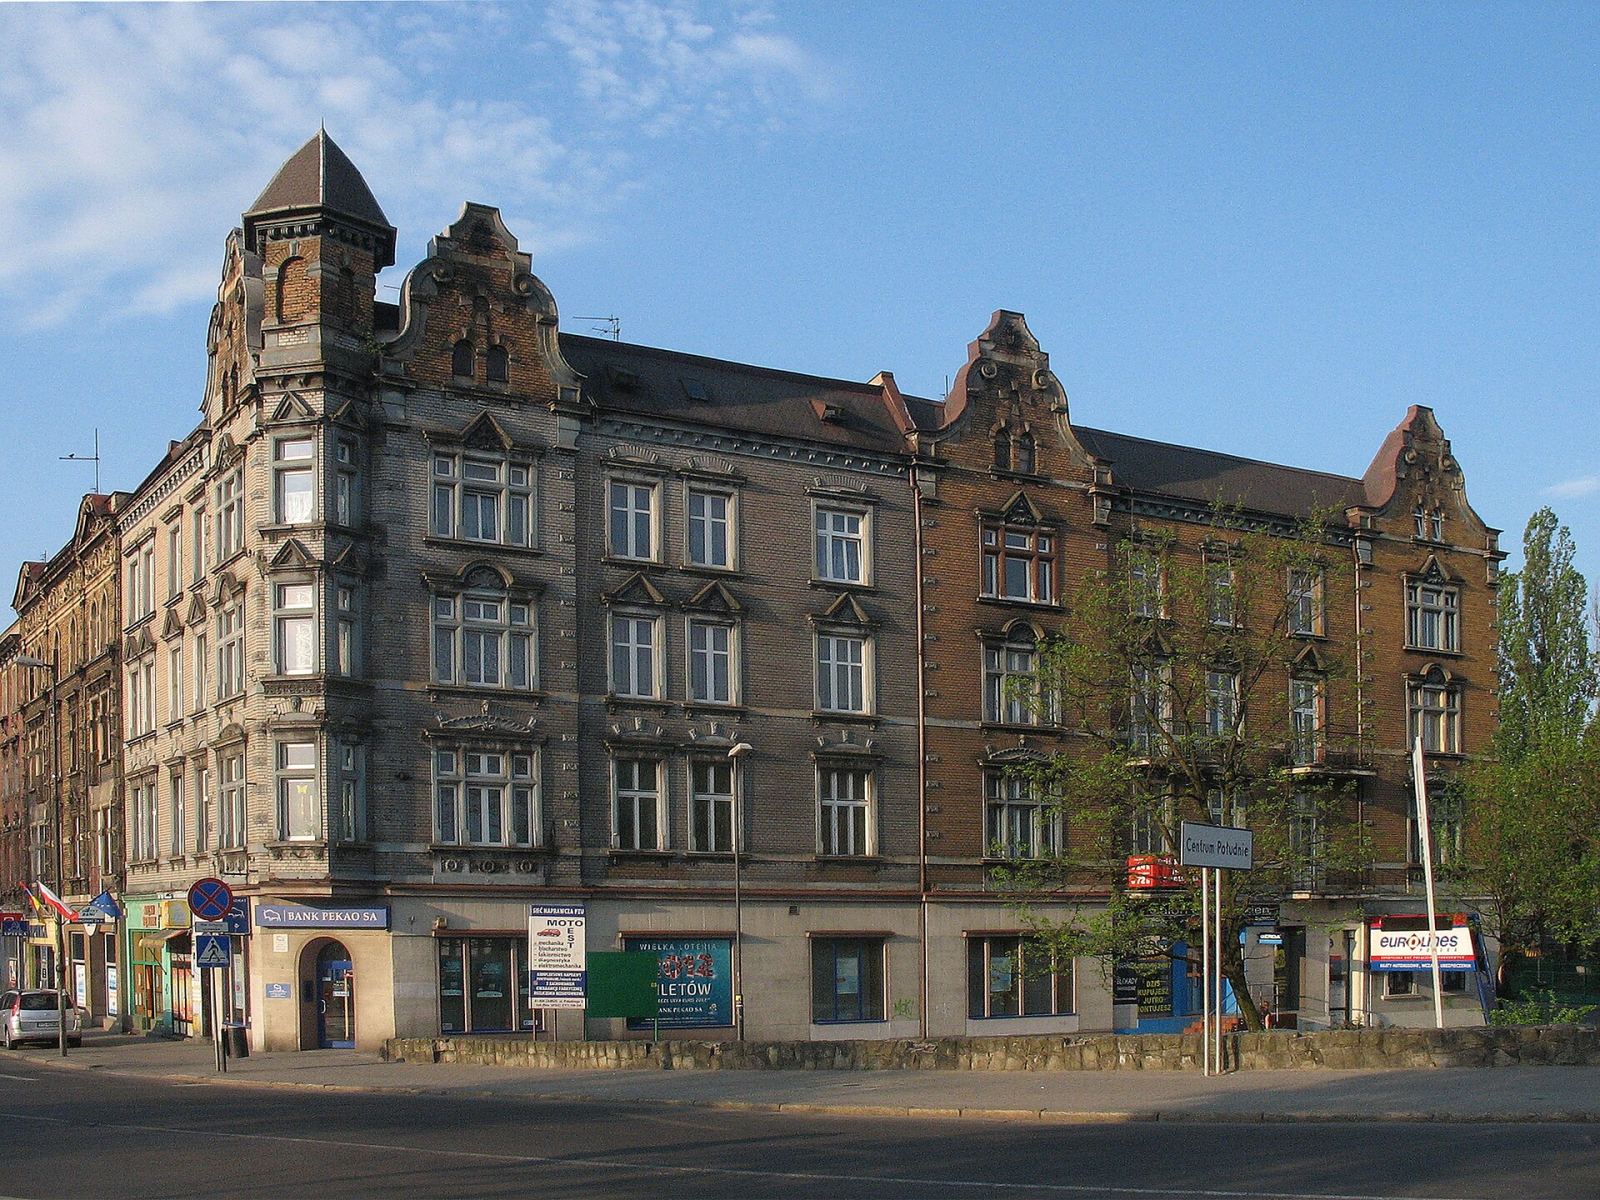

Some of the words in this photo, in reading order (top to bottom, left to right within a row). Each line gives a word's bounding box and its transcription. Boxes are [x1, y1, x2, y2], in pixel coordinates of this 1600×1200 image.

[1186, 837, 1214, 854] Centrum
[1217, 840, 1249, 857] Południe
[288, 911, 319, 921] BANK
[321, 911, 360, 921] PEKAO
[362, 911, 377, 921] SA
[547, 919, 583, 927] MOTO
[657, 954, 714, 979] 012
[657, 980, 711, 996] ILETÓW
